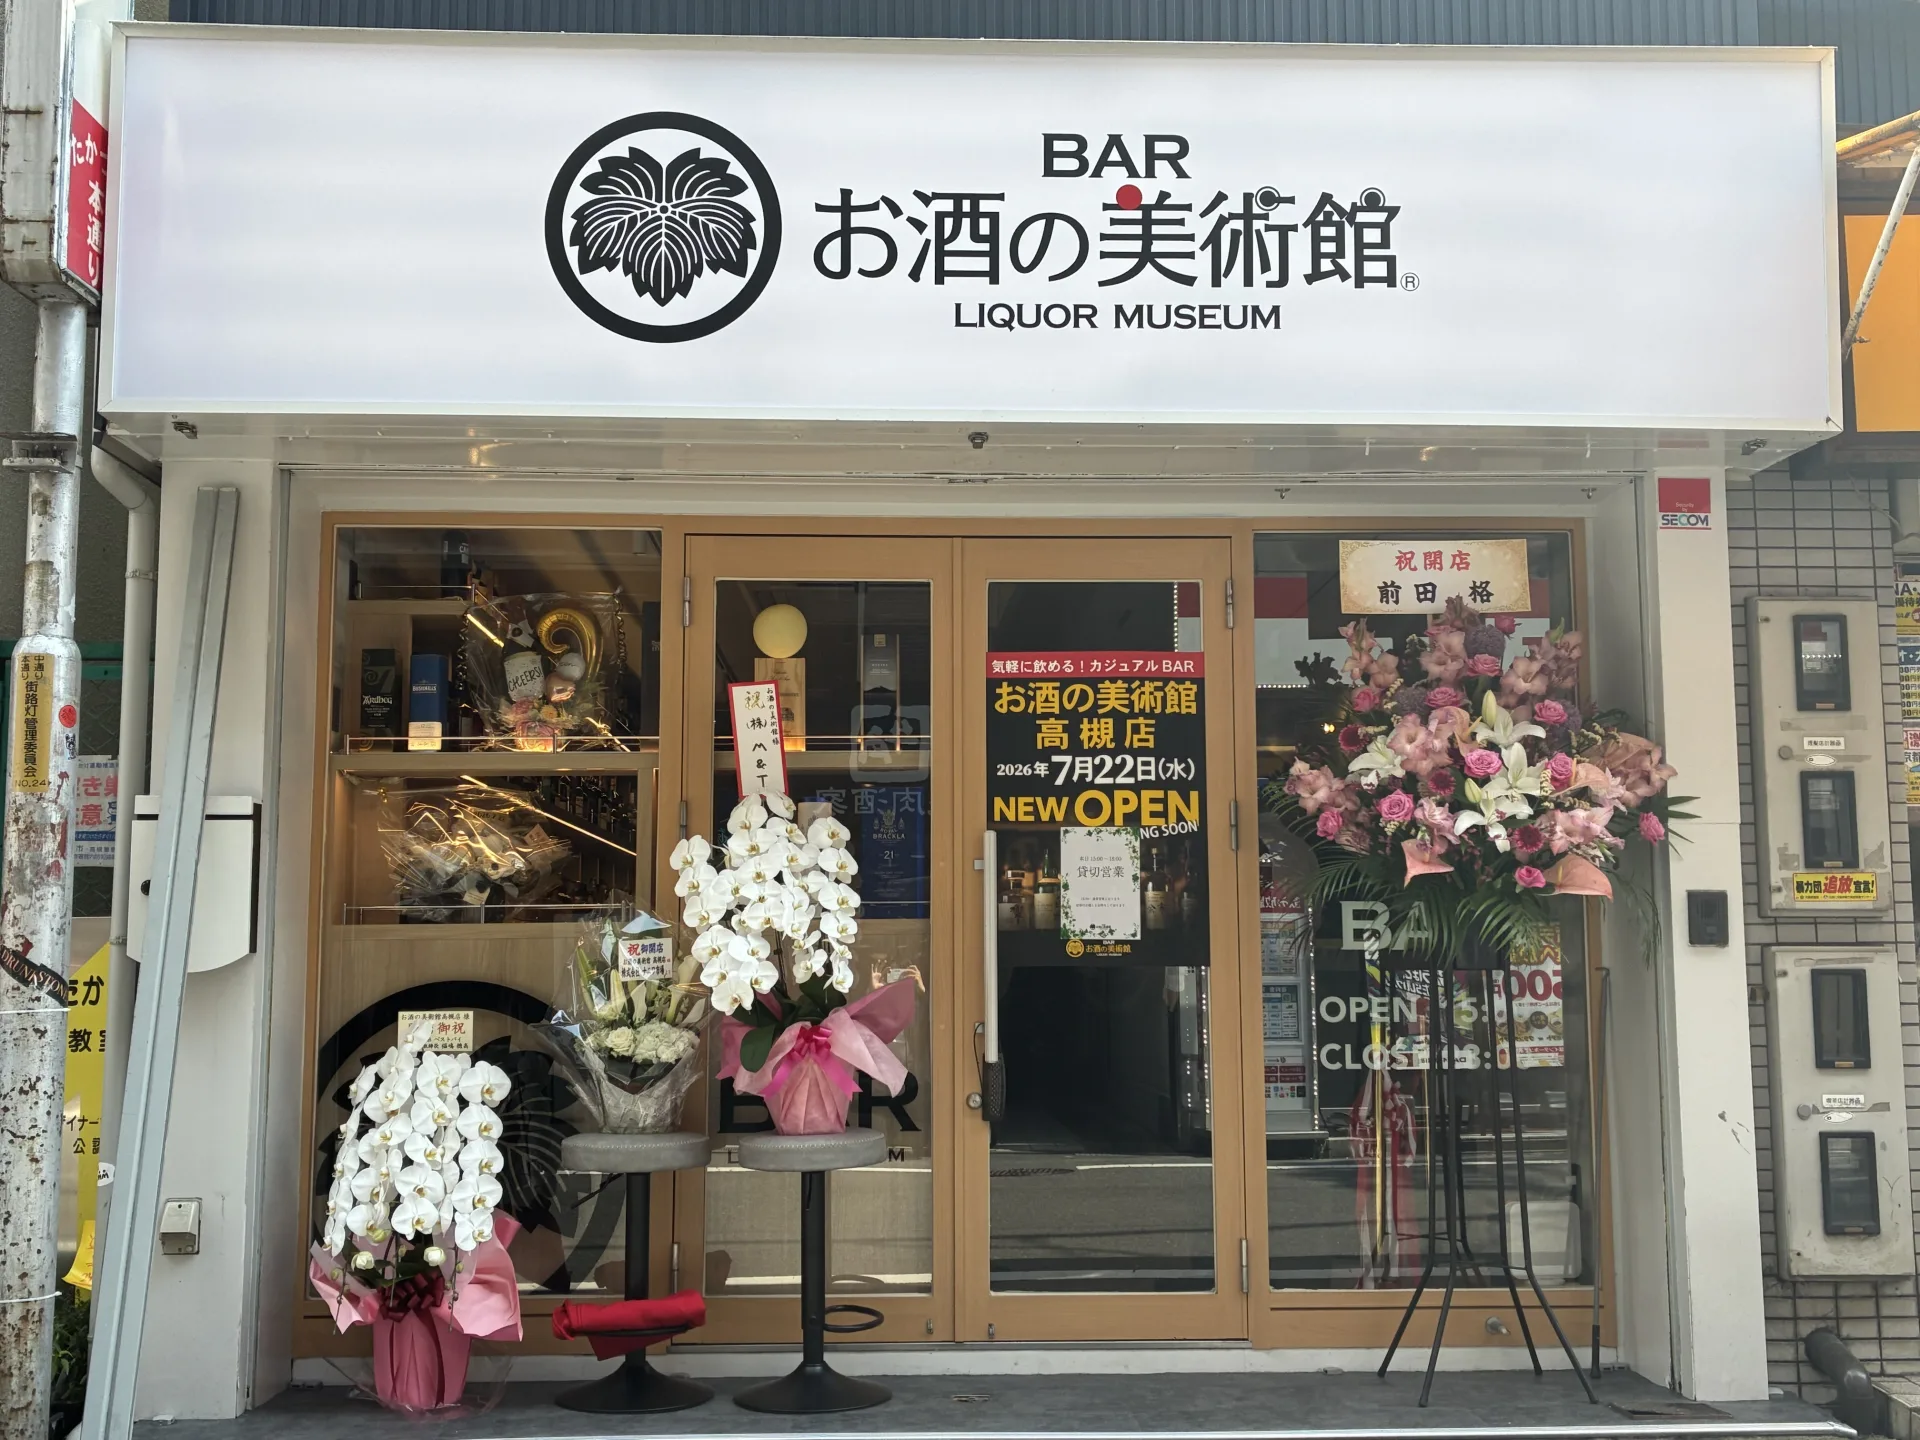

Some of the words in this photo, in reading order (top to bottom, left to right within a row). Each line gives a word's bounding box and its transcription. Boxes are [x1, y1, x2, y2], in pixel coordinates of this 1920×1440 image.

[70, 132, 107, 176] たか
[1041, 133, 1191, 178] BAR
[813, 186, 1401, 288] お酒の美術館
[954, 303, 1098, 331] LIQUOR
[1113, 304, 1281, 330] MUSEUM
[1661, 514, 1709, 526] SECOM
[1395, 550, 1471, 571] 祝開店
[1377, 580, 1438, 605] 前田
[1468, 580, 1495, 604] 格
[21, 655, 30, 680] 本通り
[34, 655, 45, 680] 中通り
[508, 666, 545, 693] CHEERS!
[1162, 660, 1195, 673] BAR
[994, 680, 1197, 714] お酒の美術館
[24, 681, 38, 777] 街路灯管理委員会
[1036, 717, 1155, 749] 高槻店
[993, 796, 1069, 822] NEW
[1074, 789, 1200, 827] OPEN
[1162, 820, 1199, 837] SOON
[884, 850, 895, 860] 21
[1077, 865, 1125, 878] 貸切営業
[1086, 944, 1131, 953] お酒の美術館
[38, 970, 68, 1000] STON
[1319, 996, 1418, 1023] OPEN
[437, 1021, 466, 1036] 御祝
